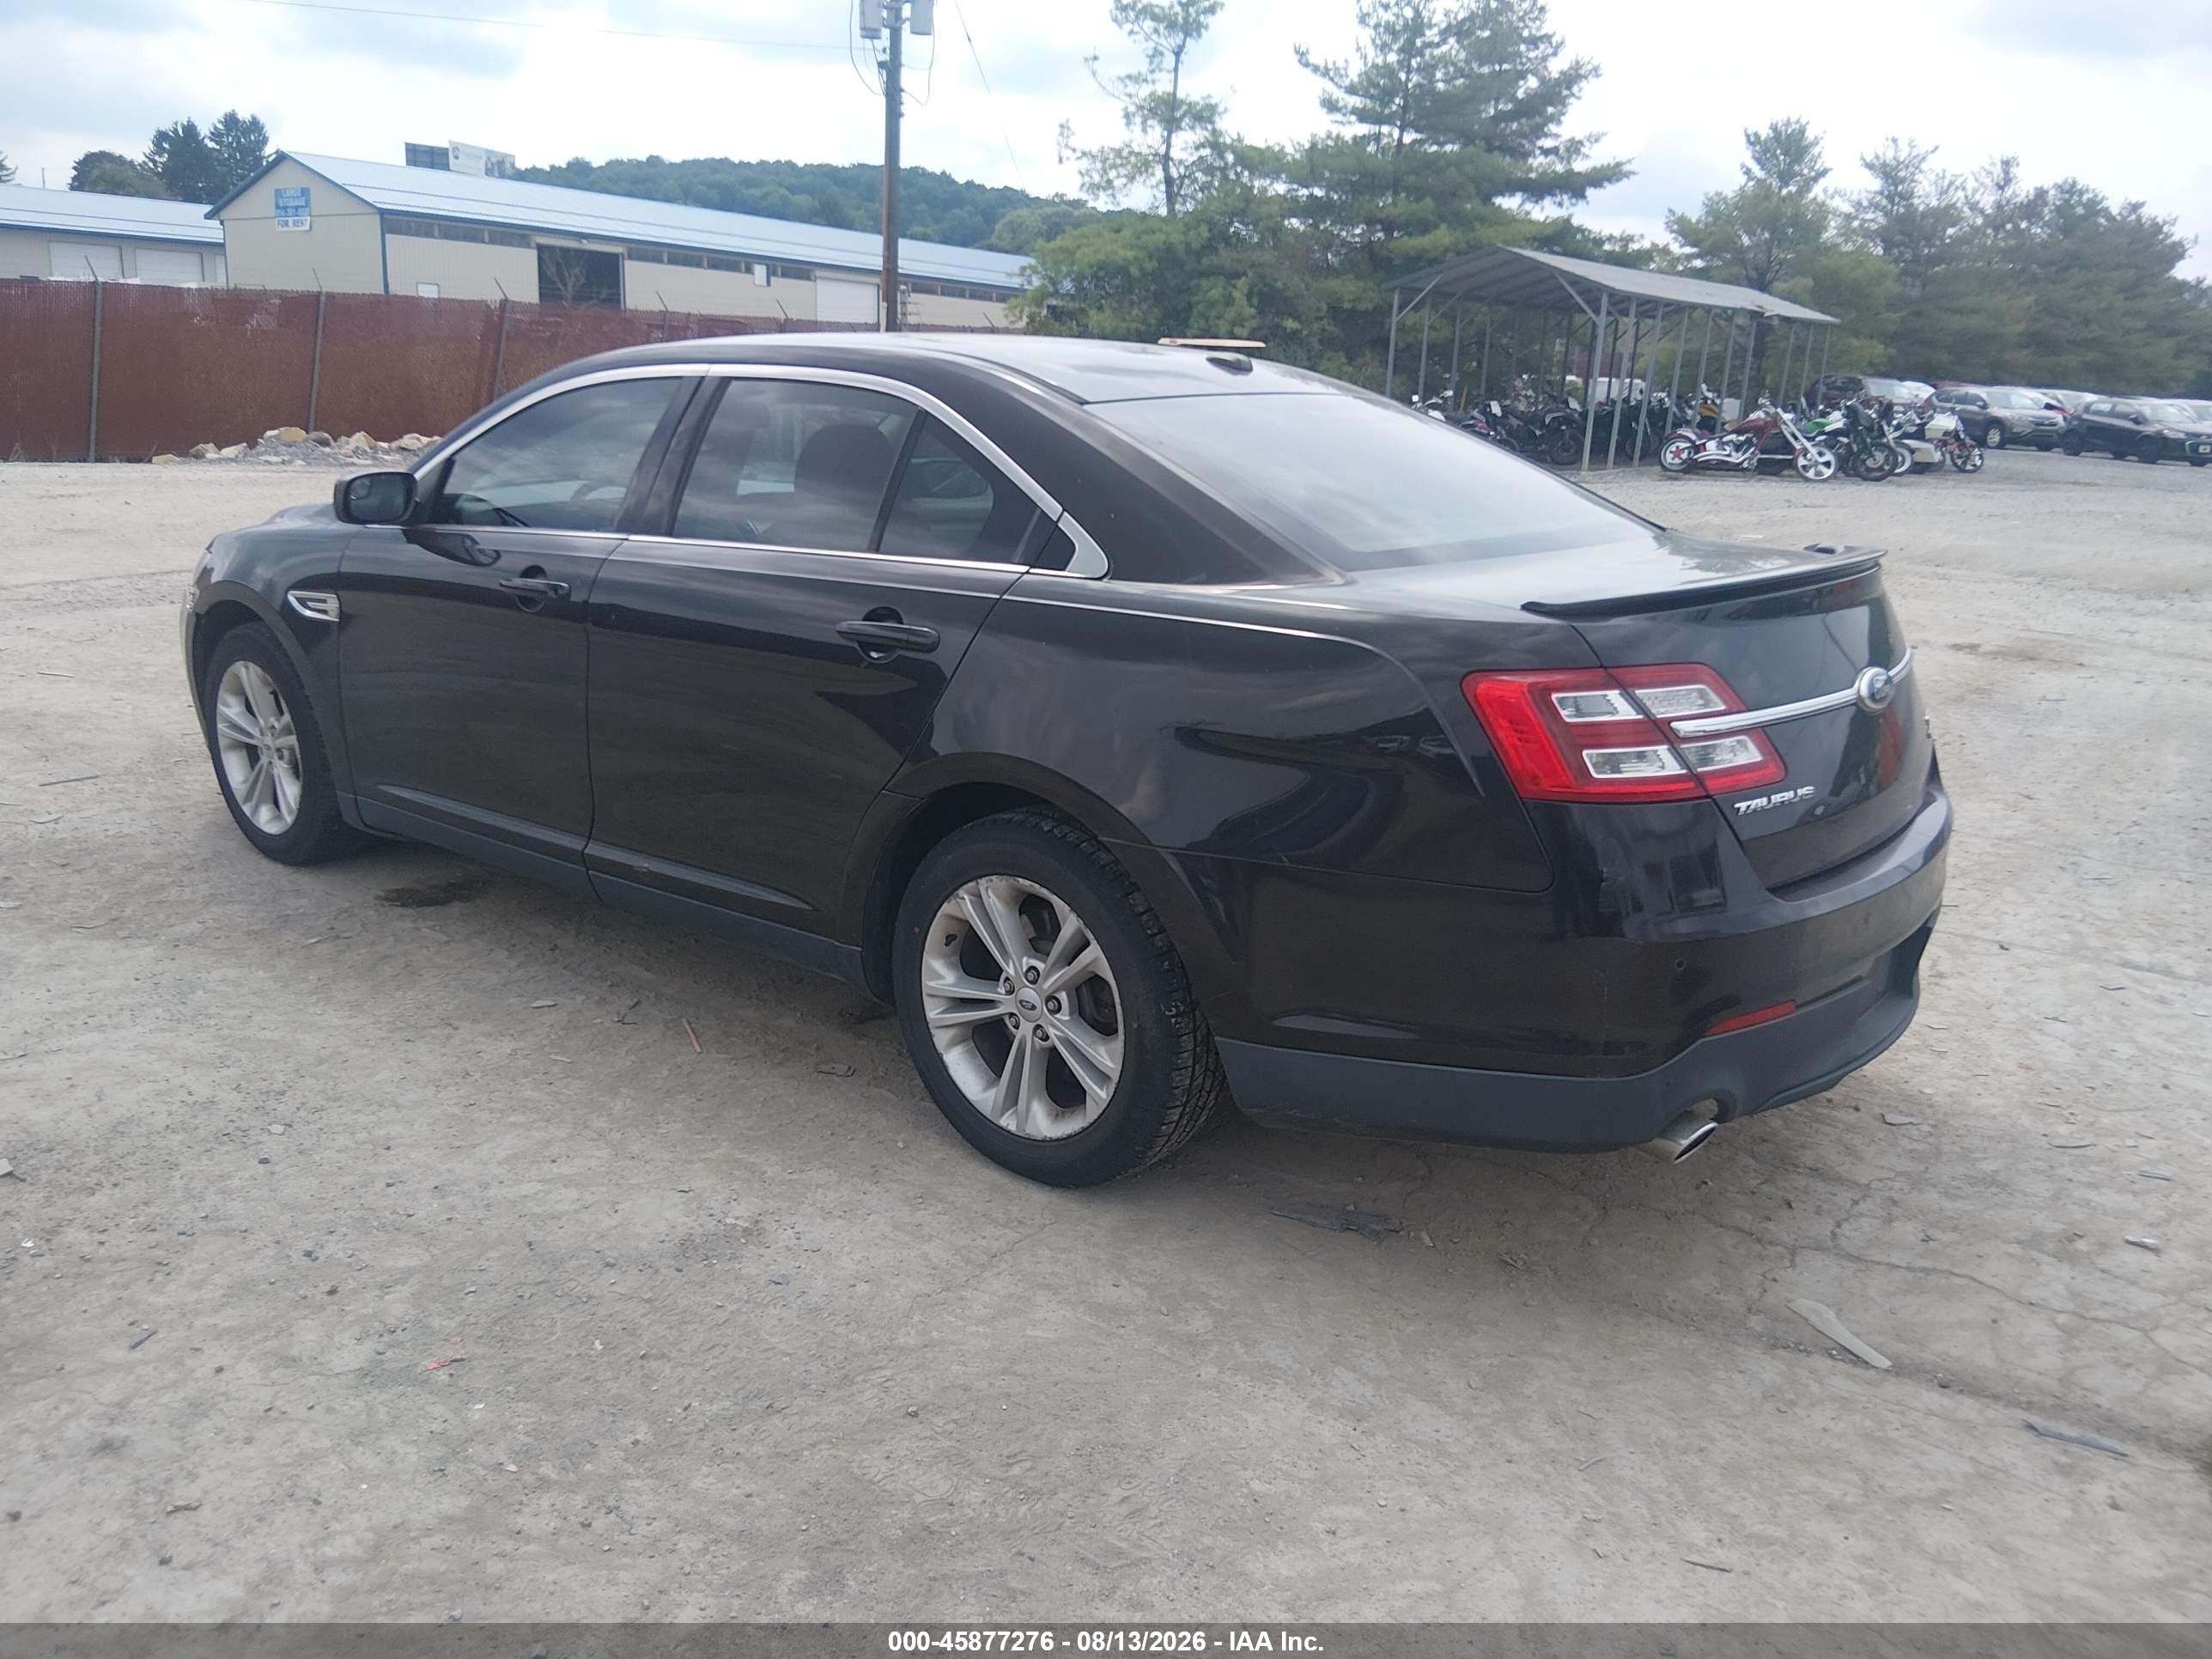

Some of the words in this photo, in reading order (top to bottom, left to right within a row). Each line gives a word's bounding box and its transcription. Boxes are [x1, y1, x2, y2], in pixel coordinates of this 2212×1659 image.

[276, 219, 289, 228] FOR
[293, 218, 308, 228] RENT
[1733, 786, 1814, 816] TAURUS
